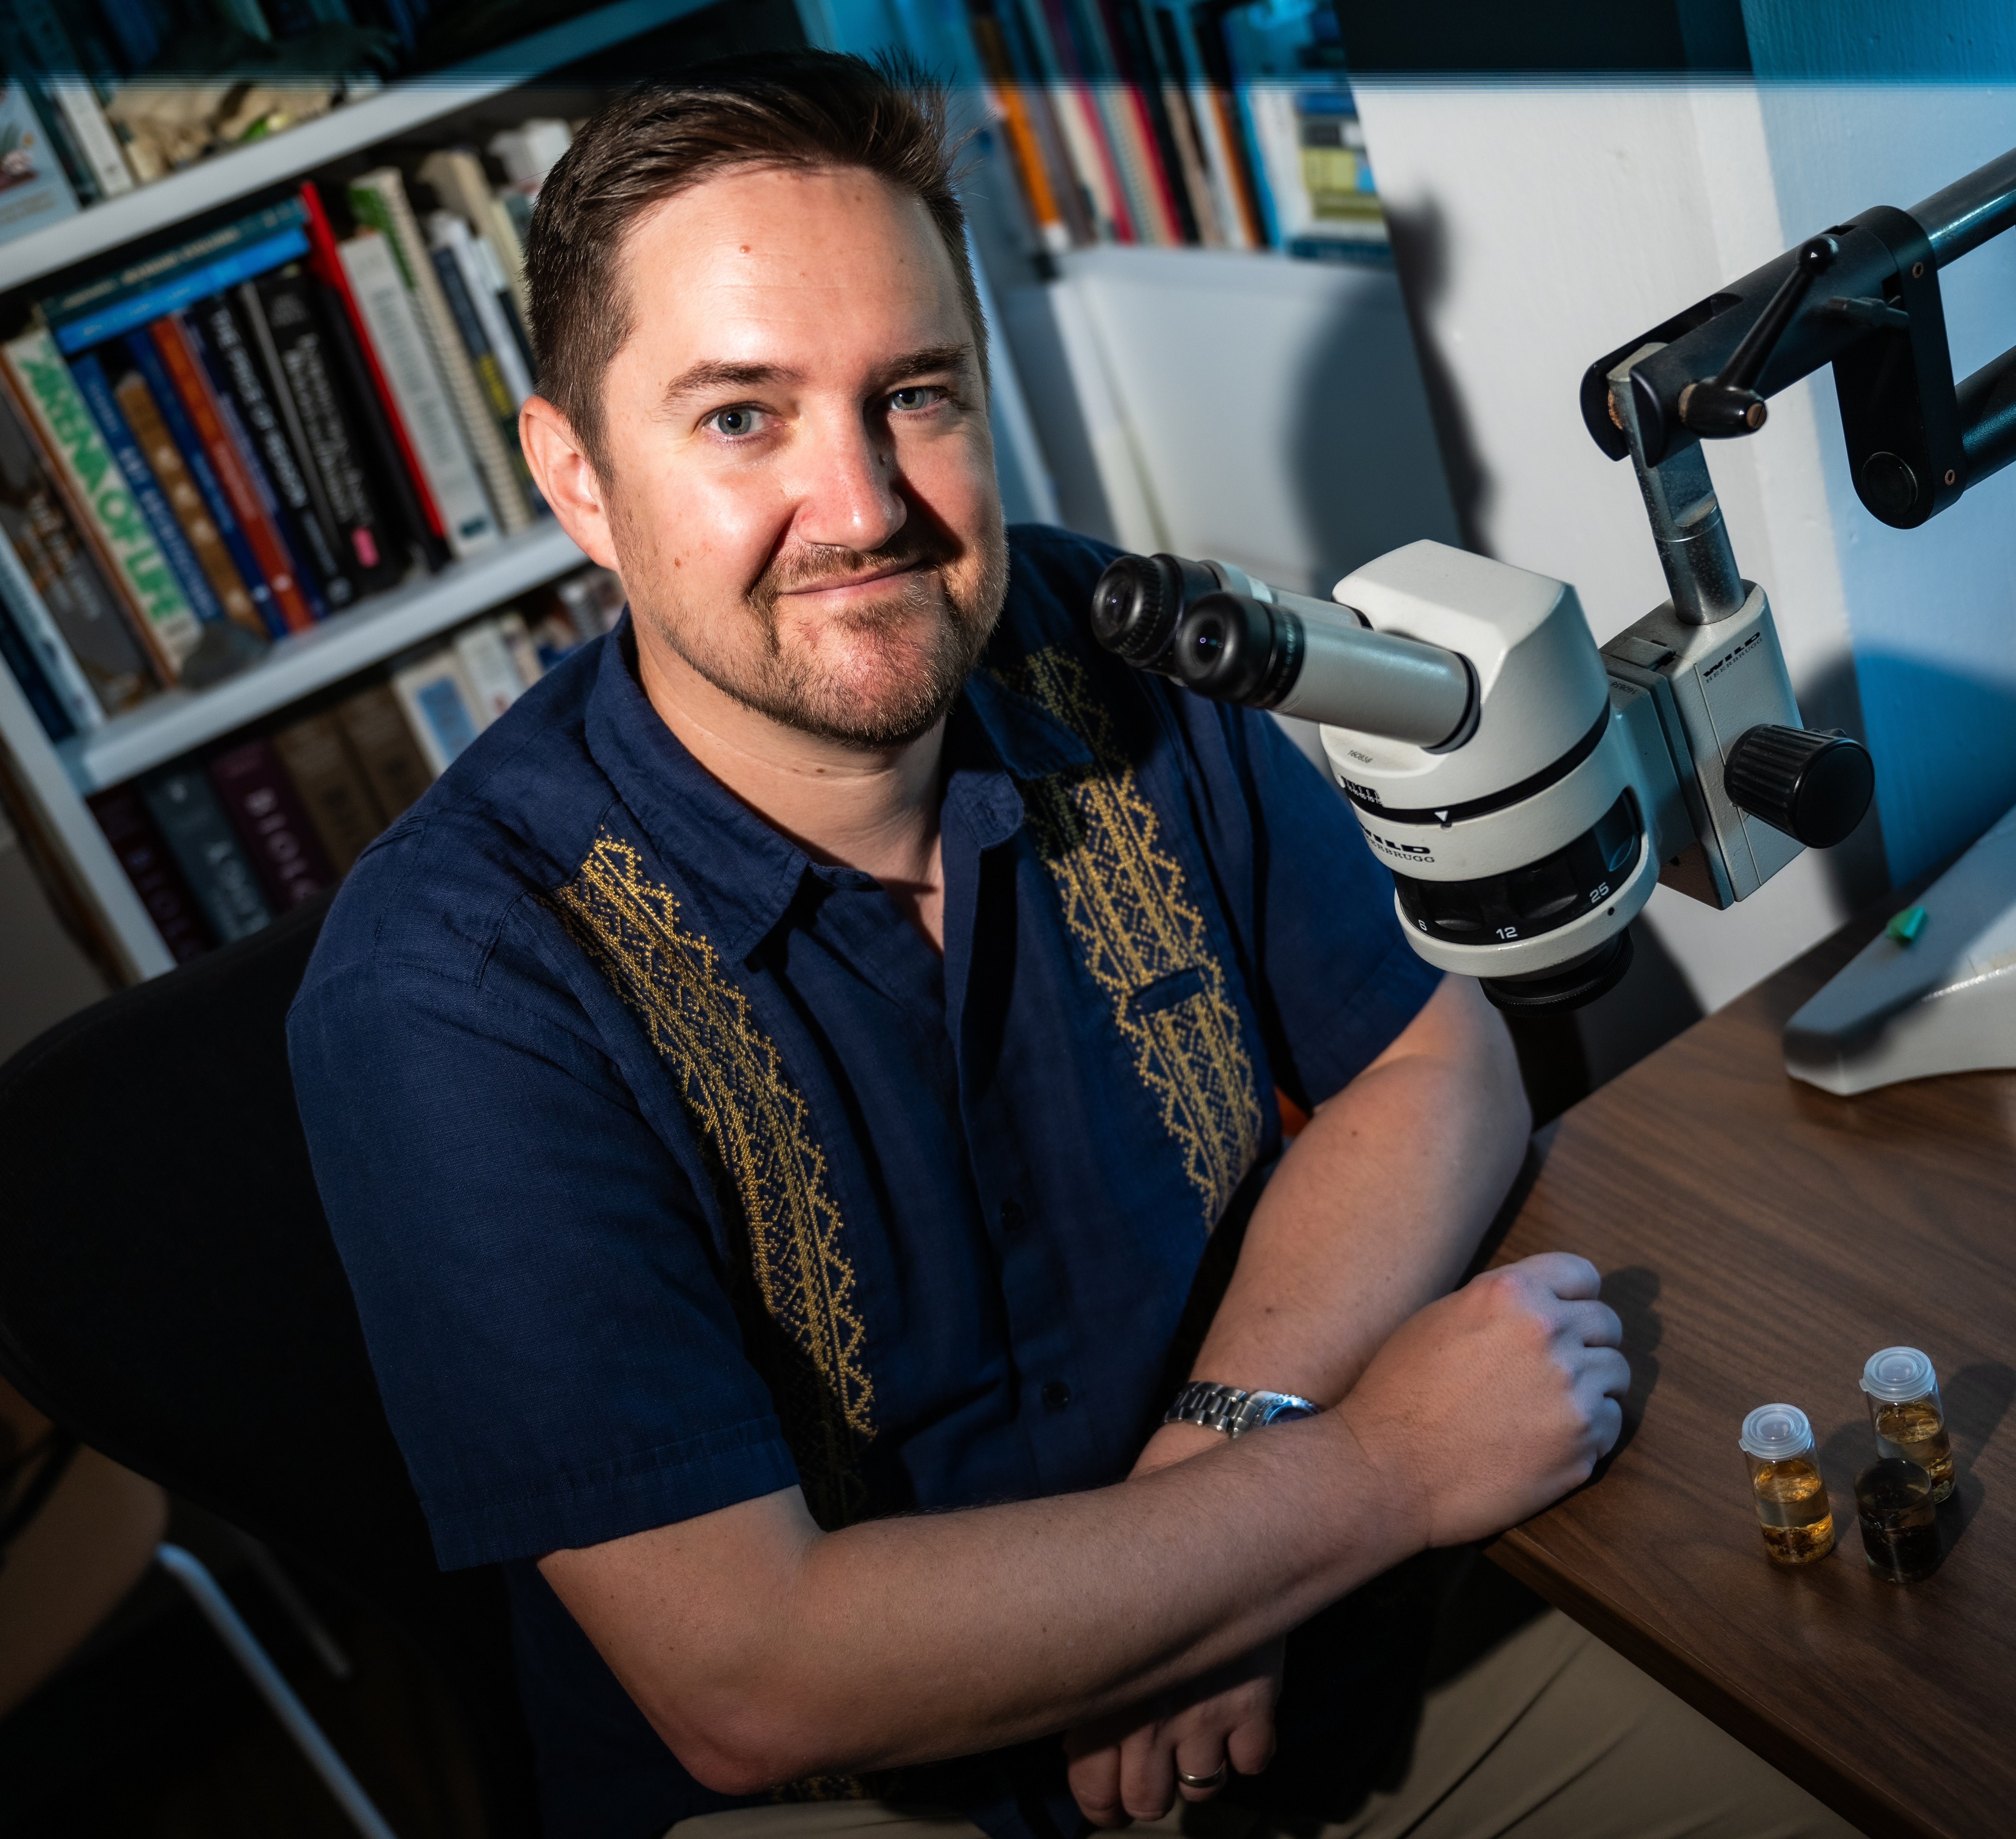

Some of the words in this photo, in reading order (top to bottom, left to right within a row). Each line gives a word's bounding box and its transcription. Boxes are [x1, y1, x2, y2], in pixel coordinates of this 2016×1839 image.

[21, 355, 112, 493] ARENA
[98, 491, 149, 538] OF
[124, 545, 189, 625] LIFE
[1703, 632, 1760, 677] WILD
[1706, 638, 1762, 683] HEERBRUGG
[1590, 882, 1609, 903] 25
[1418, 920, 1427, 931] 6
[1495, 926, 1518, 939] 12
